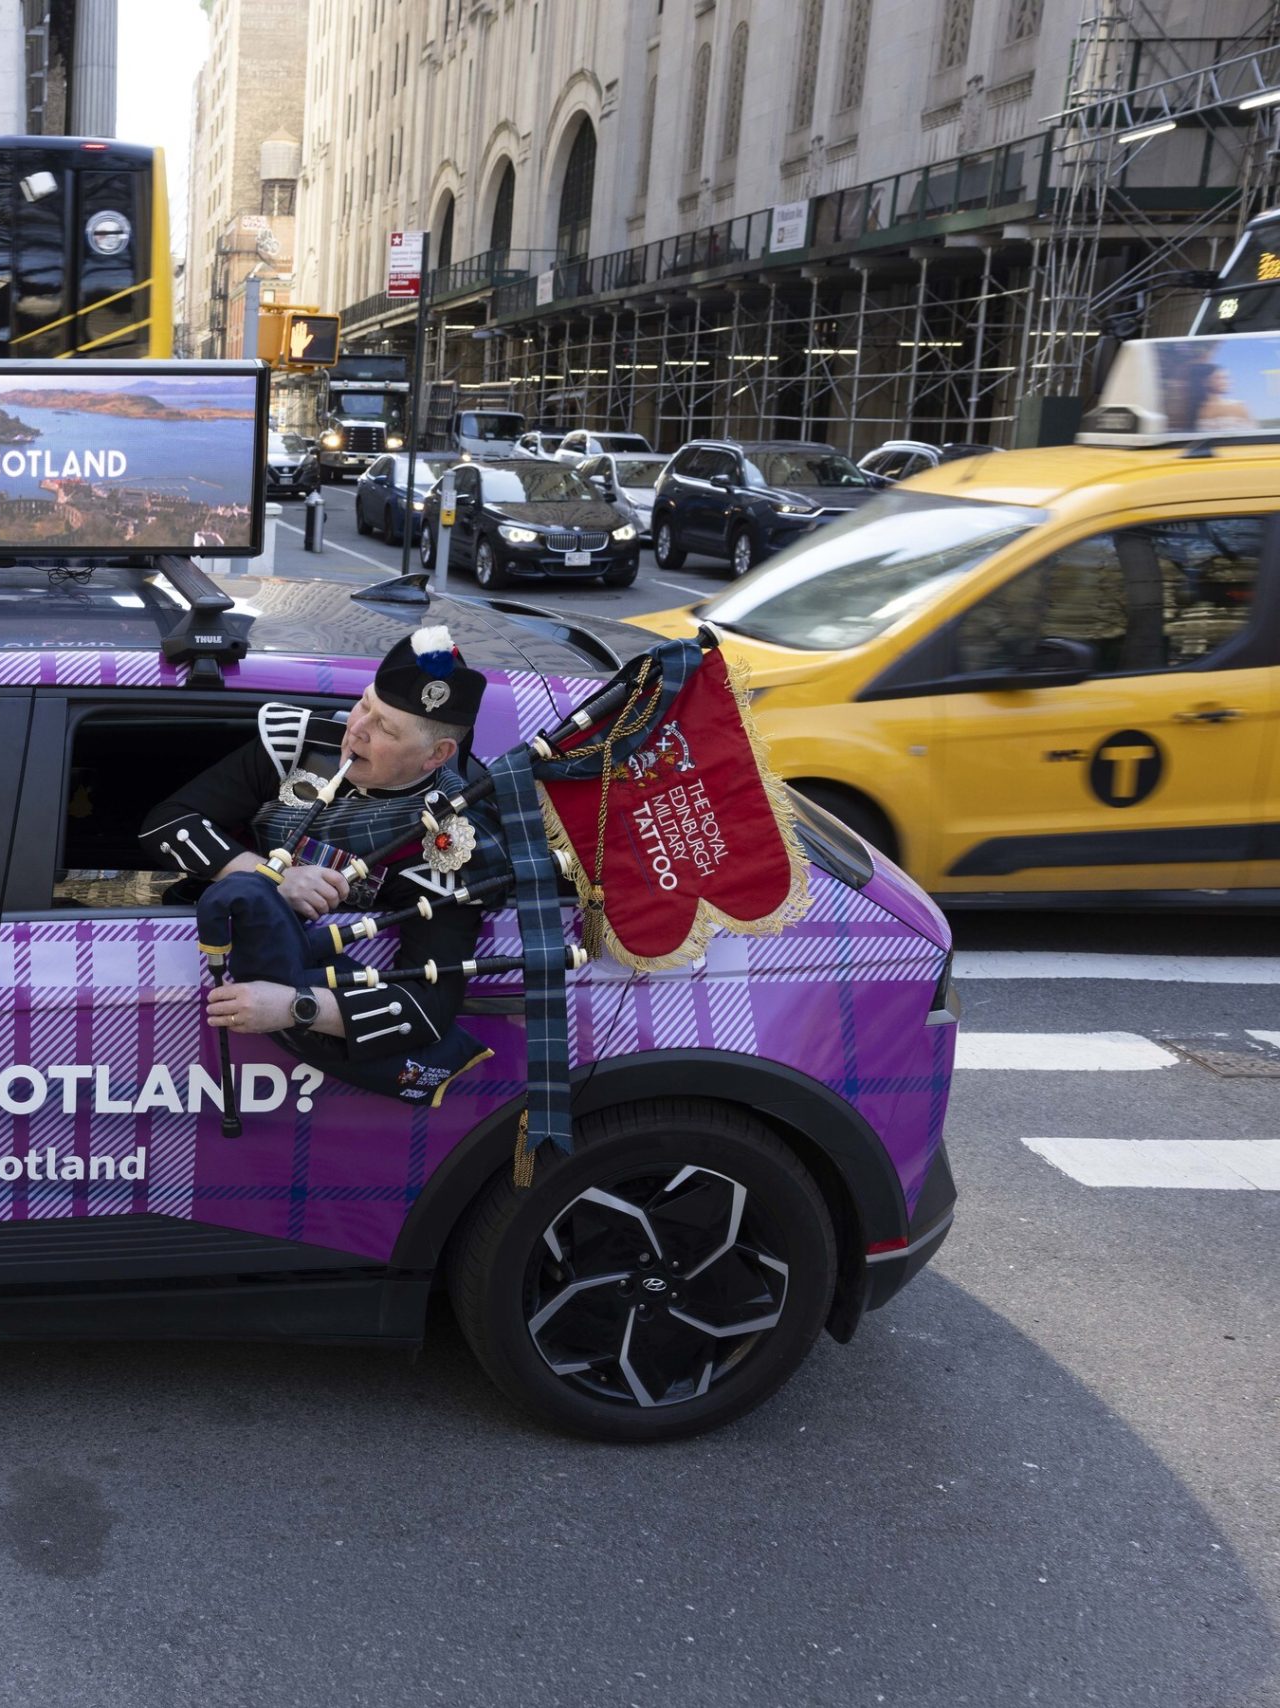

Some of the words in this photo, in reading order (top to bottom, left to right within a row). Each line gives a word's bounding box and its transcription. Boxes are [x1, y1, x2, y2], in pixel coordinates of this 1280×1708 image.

[194, 634, 222, 644] THULE
[1101, 745, 1154, 798] T
[632, 801, 678, 891] TATTOO
[652, 793, 689, 861] MILITARY
[668, 785, 715, 877] EDINBURGH
[688, 778, 711, 814] THE
[700, 811, 728, 865] ROYAL
